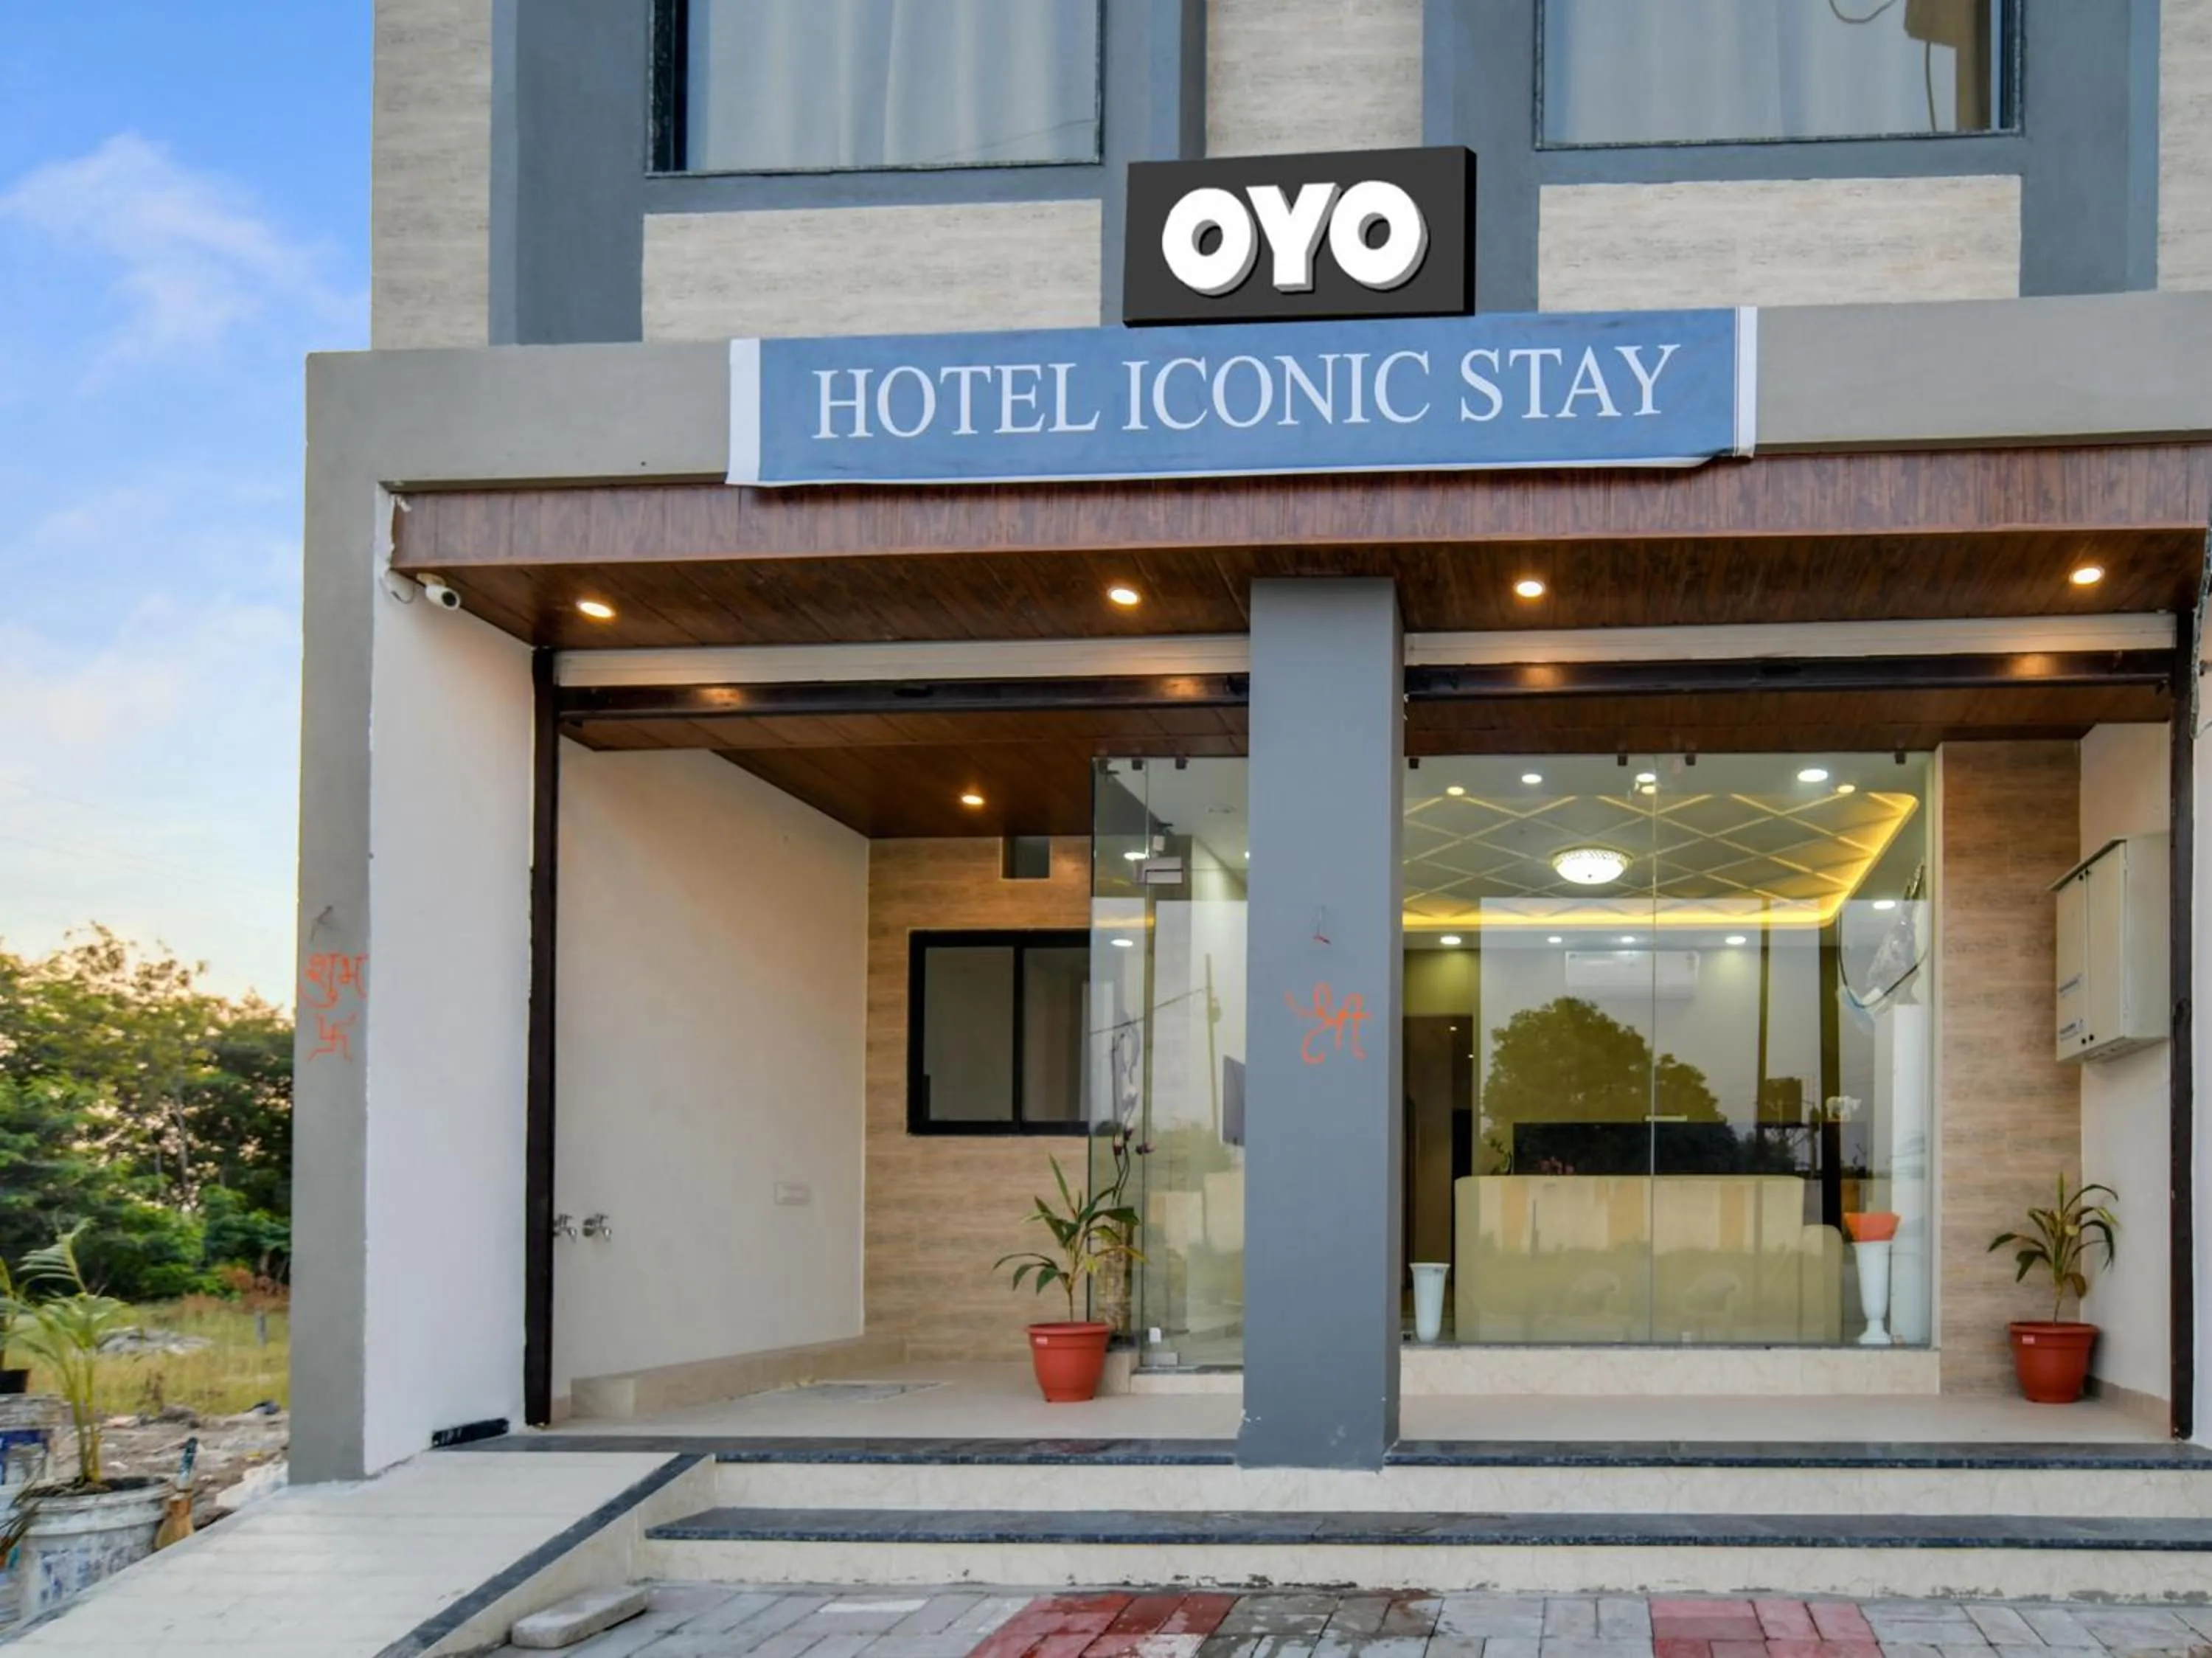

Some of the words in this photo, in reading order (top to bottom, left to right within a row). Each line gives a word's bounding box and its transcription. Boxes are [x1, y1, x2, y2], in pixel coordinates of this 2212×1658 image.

[1161, 180, 1429, 296] OYO
[813, 364, 1099, 439] HOTEL
[1122, 351, 1430, 430] ICONIC
[1459, 344, 1681, 422] STAY
